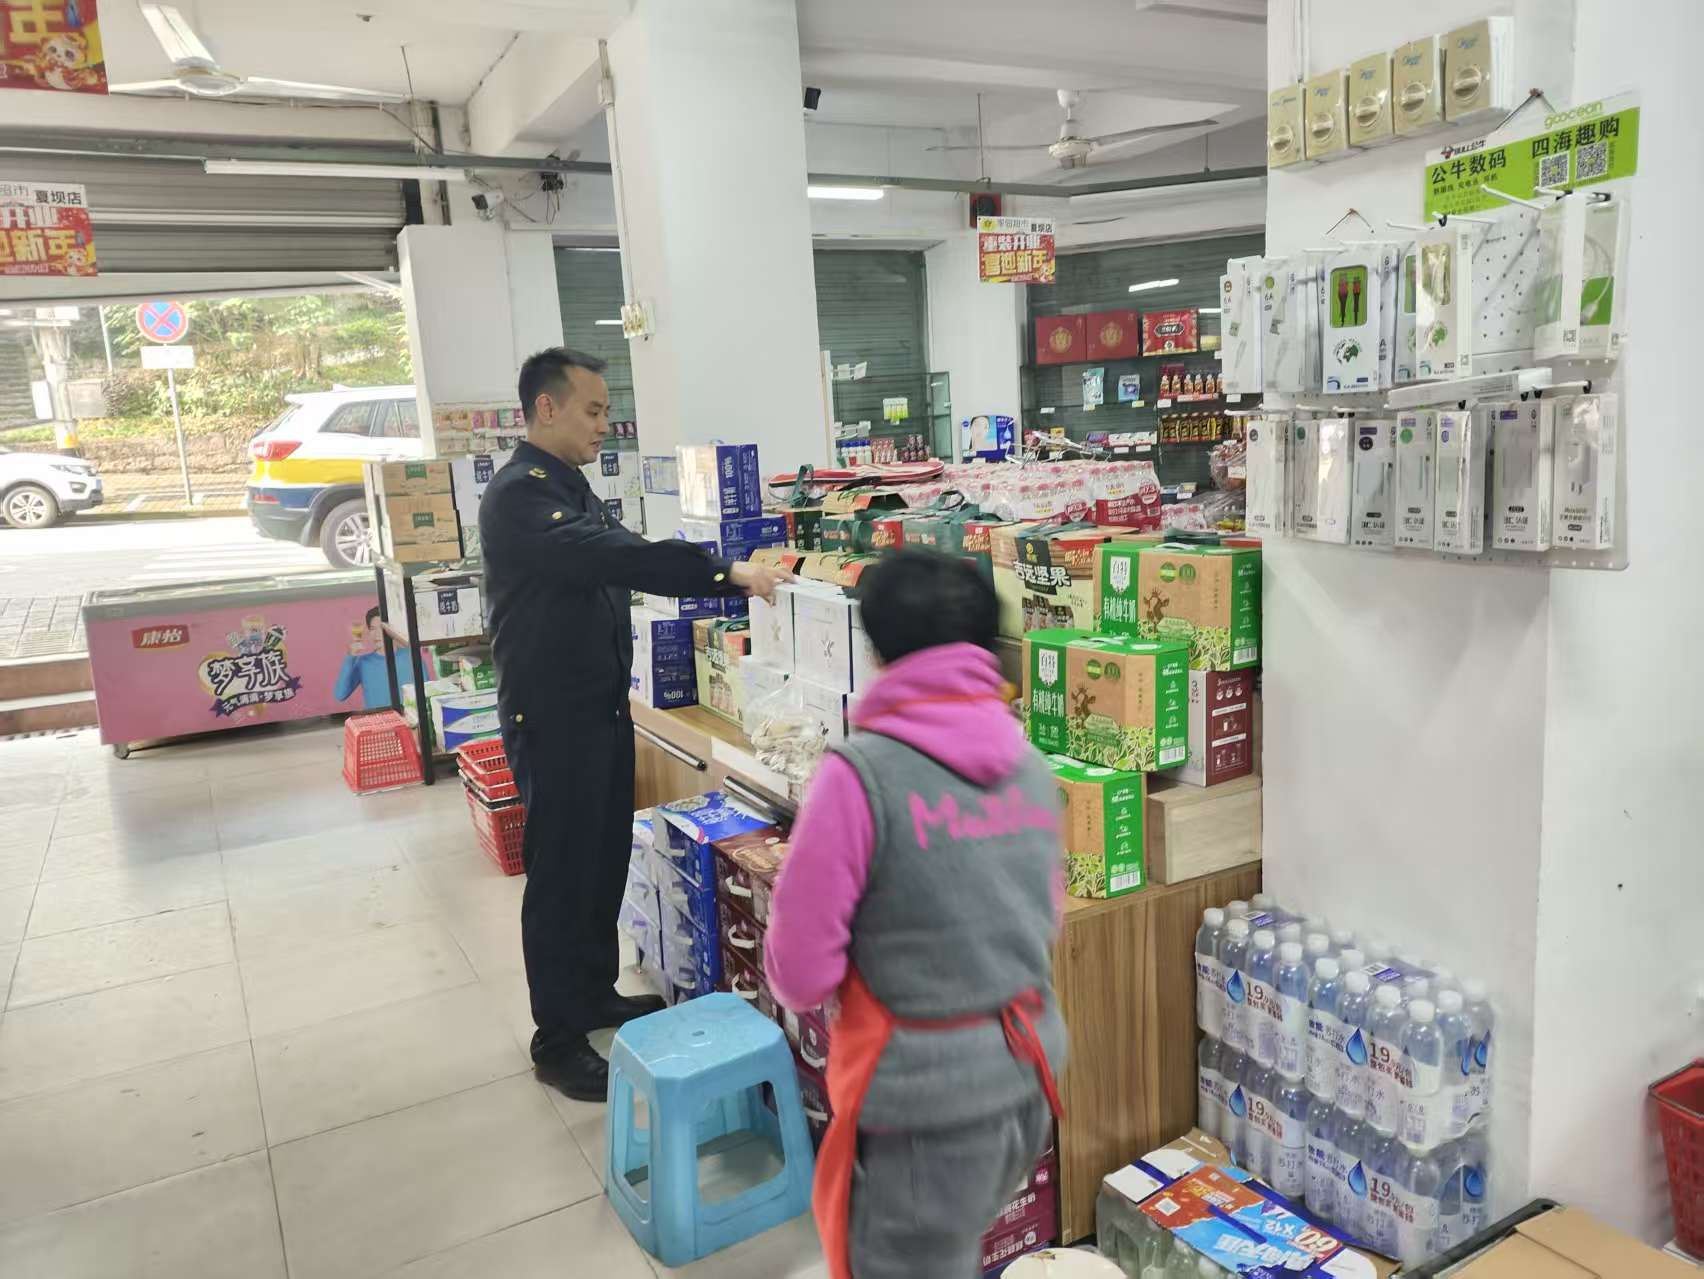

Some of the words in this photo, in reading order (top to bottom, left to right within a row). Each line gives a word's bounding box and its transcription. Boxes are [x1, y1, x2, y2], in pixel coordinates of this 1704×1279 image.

[1531, 116, 1621, 159] 四海趣购
[1431, 149, 1507, 185] 公牛数码
[983, 249, 1048, 277] 喜迎新年
[1246, 982, 1264, 1000] 19
[1370, 1042, 1391, 1063] 19
[1248, 1097, 1265, 1116] 19
[1370, 1177, 1391, 1197] 19
